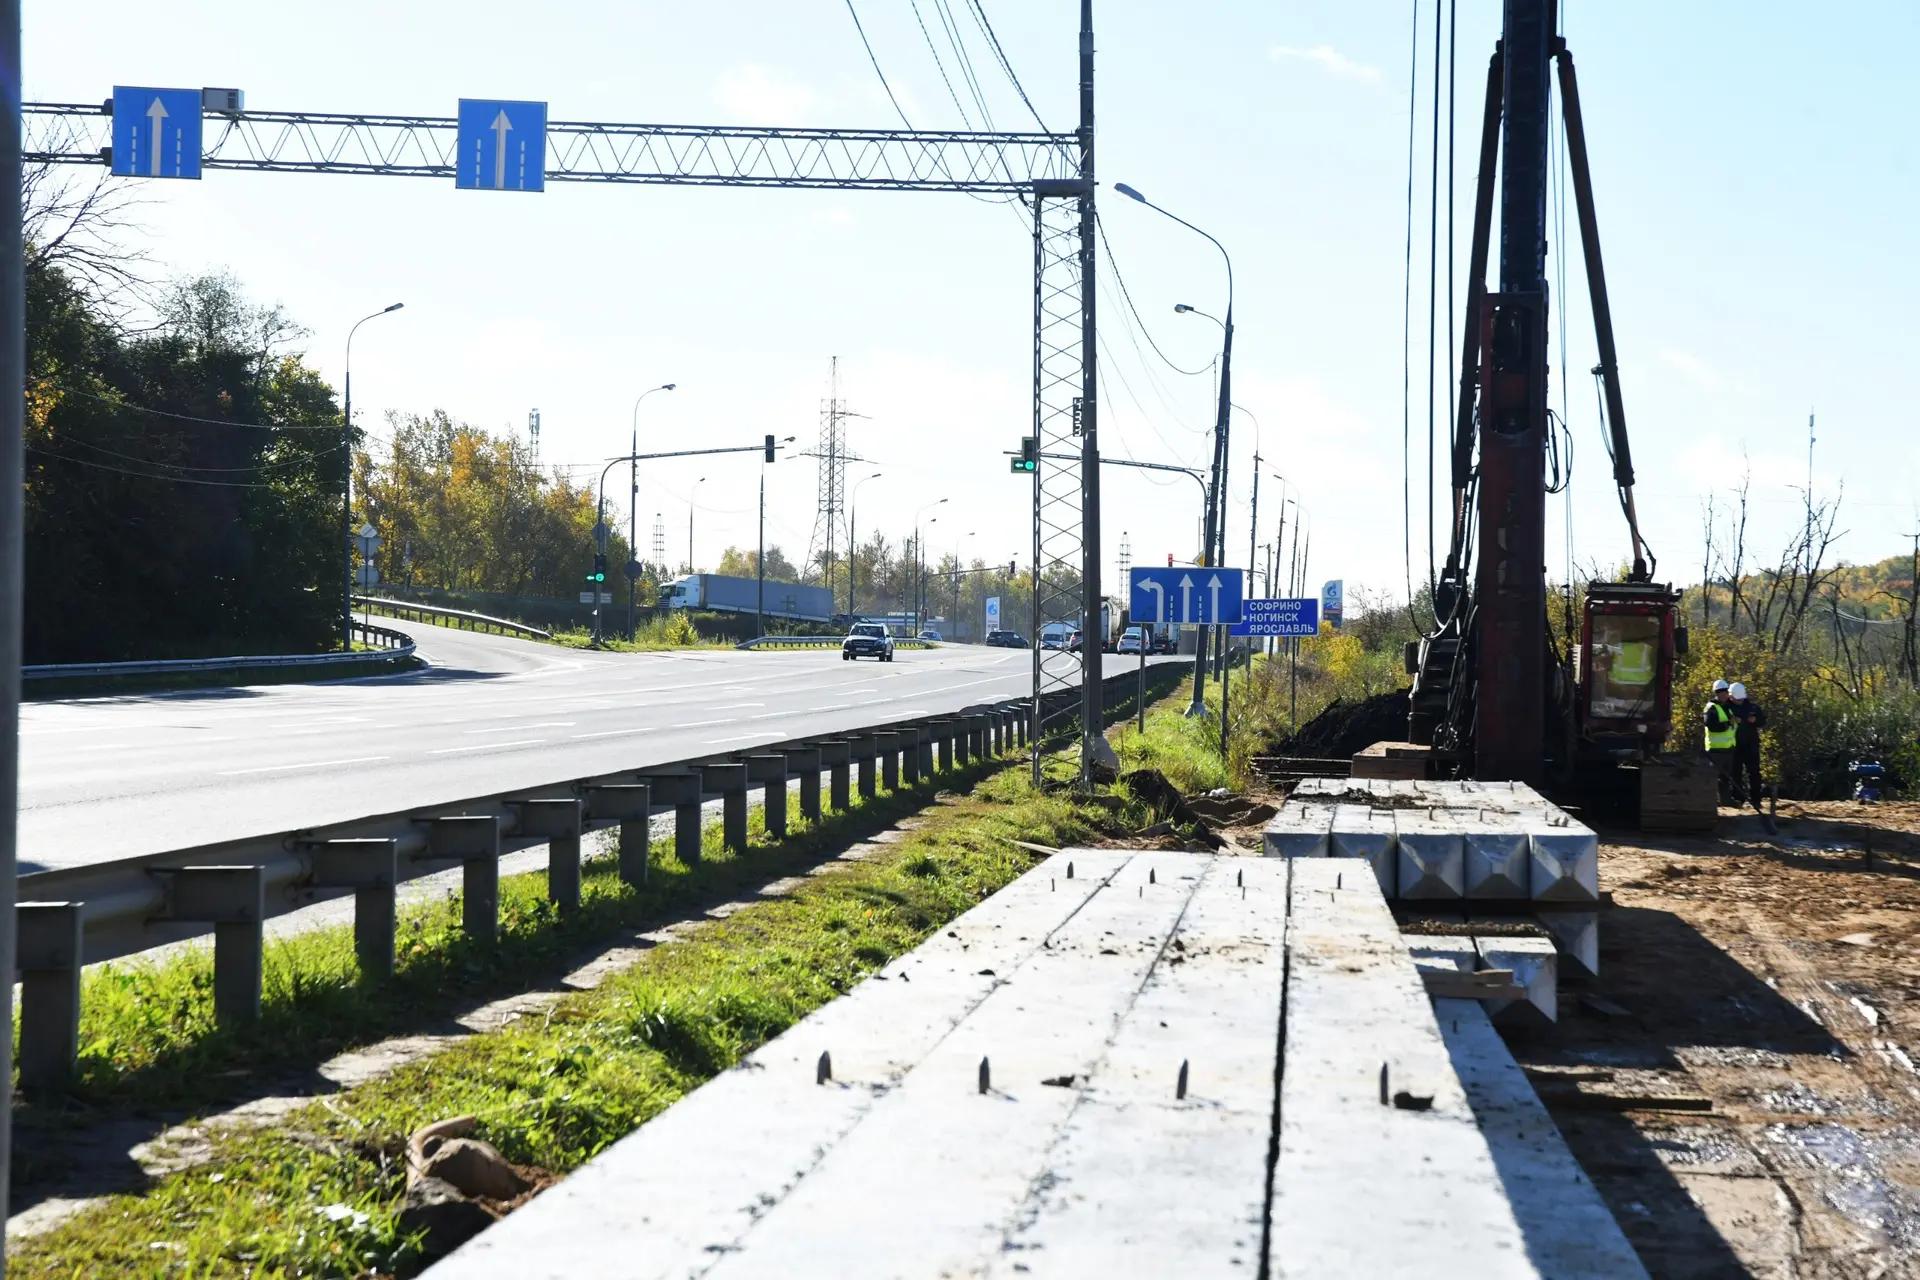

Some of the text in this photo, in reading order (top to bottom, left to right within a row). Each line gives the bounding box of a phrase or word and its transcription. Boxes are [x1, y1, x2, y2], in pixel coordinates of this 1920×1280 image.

[1249, 601, 1302, 611] СОФРИНО
[1249, 613, 1299, 622] НОГИНСК
[1249, 624, 1314, 634] ЯРОСЛАВЛЬ
